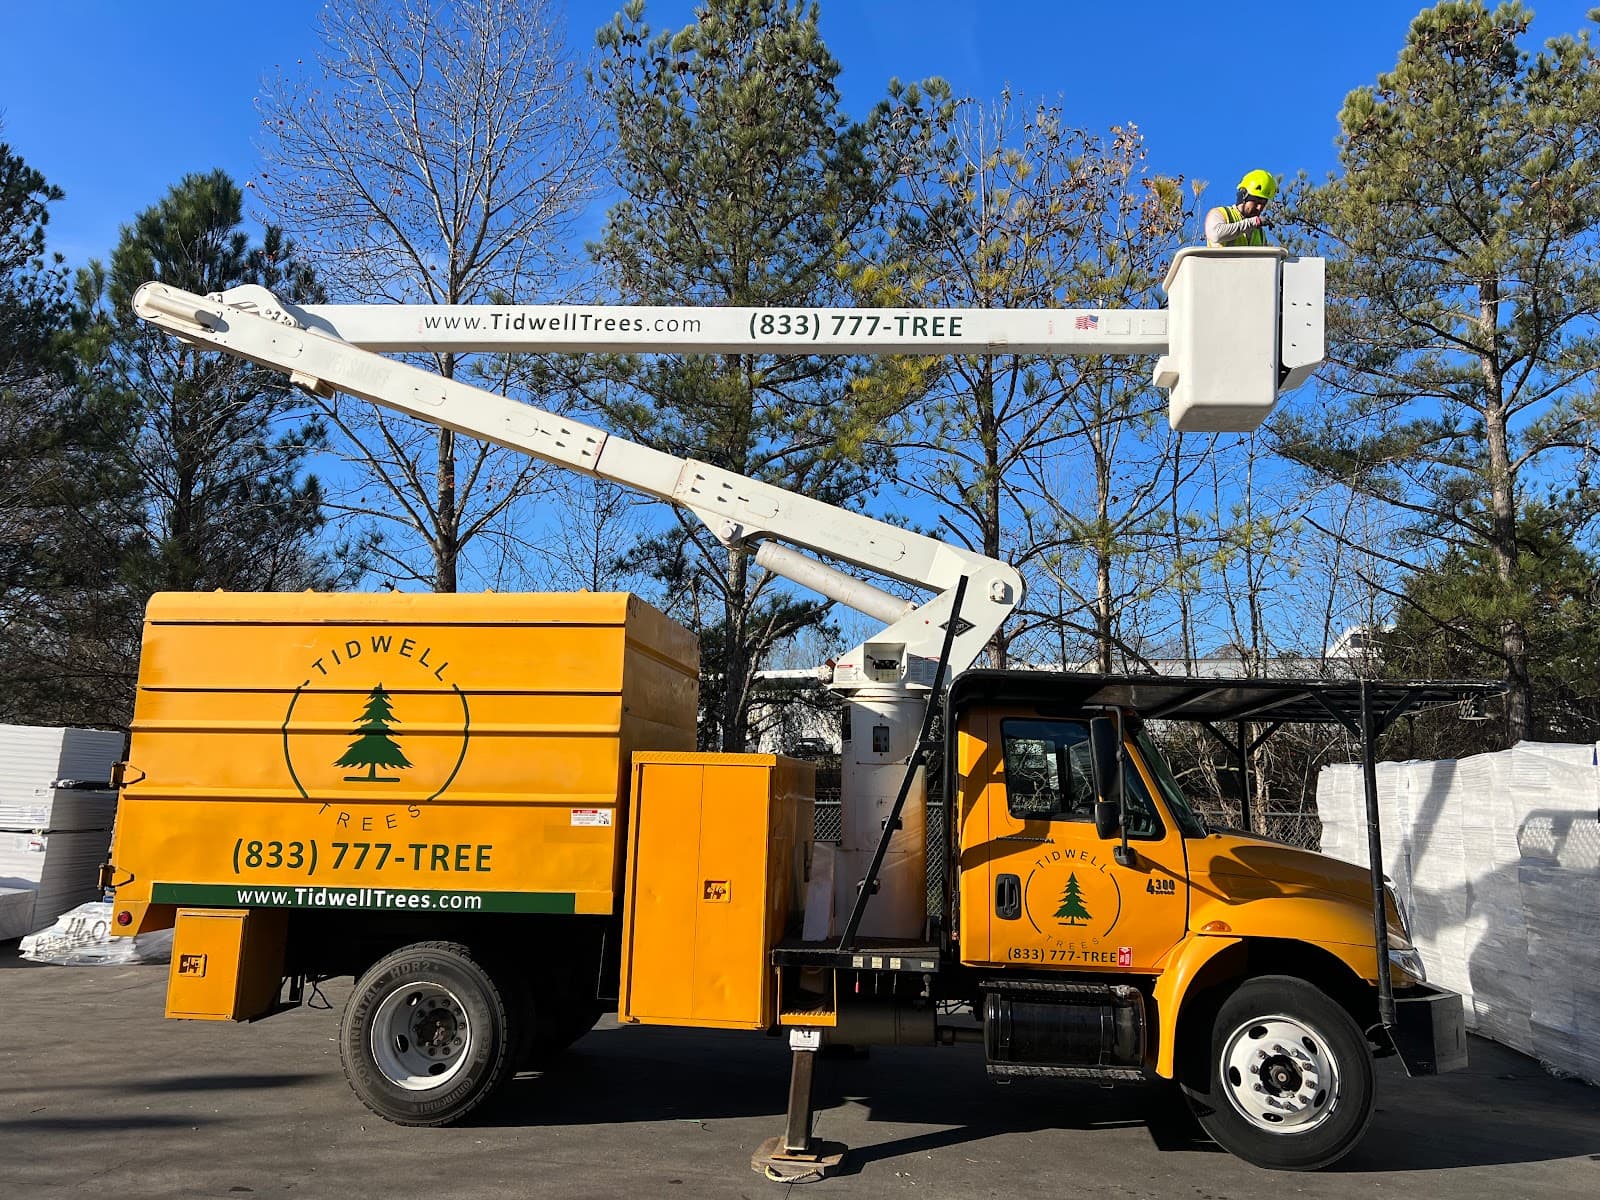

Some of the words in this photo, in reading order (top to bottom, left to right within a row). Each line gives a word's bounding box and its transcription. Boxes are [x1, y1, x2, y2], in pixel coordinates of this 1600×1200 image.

[424, 313, 701, 332] www.TidwellTrees.com
[749, 312, 821, 340] (833)
[831, 315, 963, 337] 777-TREE
[311, 635, 449, 682] TIDWELL
[318, 801, 421, 831] TREES
[233, 838, 318, 876] (833)
[331, 842, 493, 872] 777-TREE
[1035, 849, 1107, 873] TIDWELL
[1147, 879, 1176, 894] 4300
[237, 887, 482, 909] www.TidwellTrees.com
[1046, 935, 1100, 950] TREES
[1008, 947, 1045, 962] (833)
[1049, 949, 1117, 963] 777-TREE
[389, 961, 431, 979] HDR2
